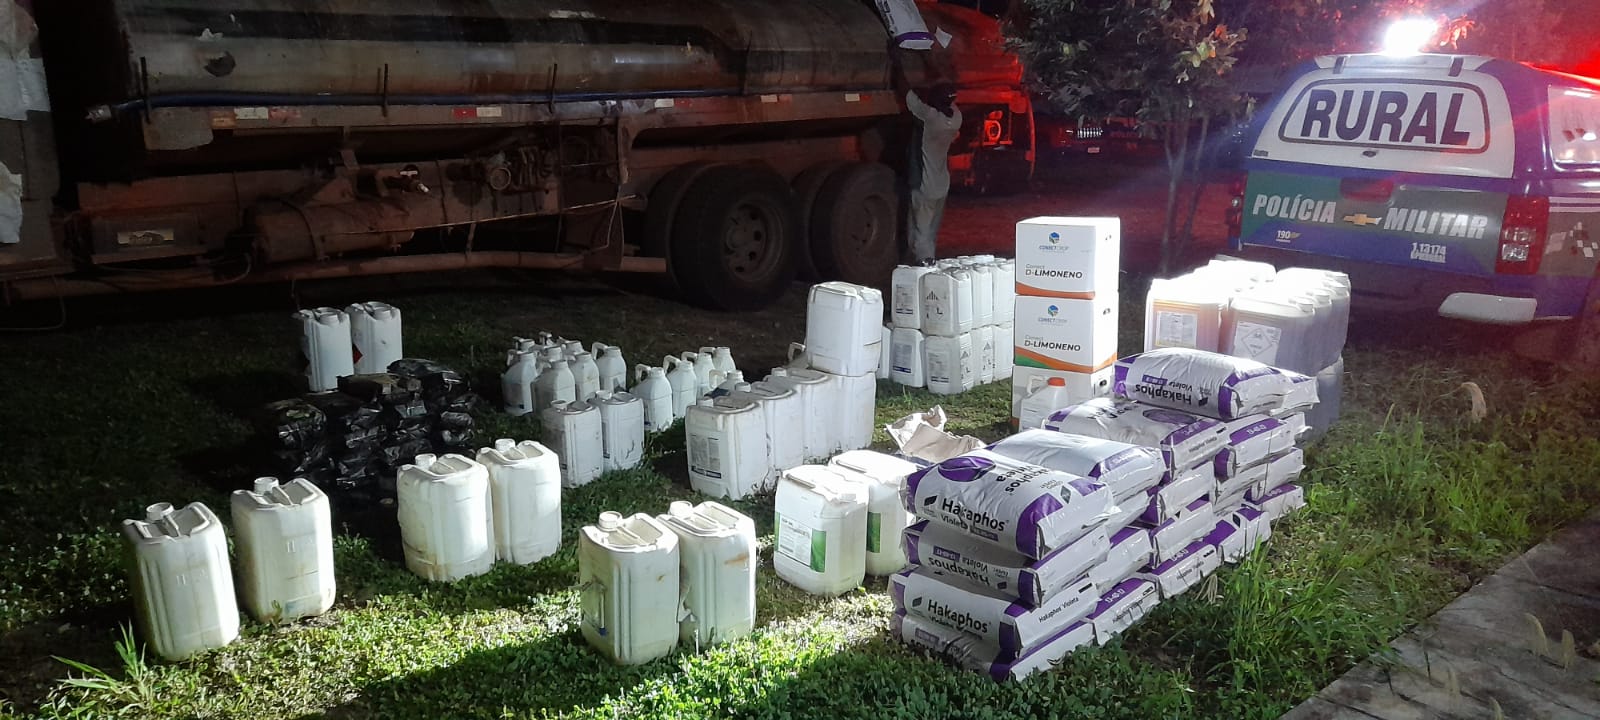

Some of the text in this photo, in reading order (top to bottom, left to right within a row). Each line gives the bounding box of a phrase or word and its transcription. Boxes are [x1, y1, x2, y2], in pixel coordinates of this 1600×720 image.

[1300, 88, 1471, 146] RURAL
[1252, 193, 1489, 240] POLÍCIA MILITAR
[1277, 230, 1291, 239] 190
[1025, 269, 1083, 279] D-LIMONENO
[1024, 340, 1081, 352] D-LIMONENO
[1135, 384, 1192, 405] Hakaphos
[941, 497, 1005, 532] Hakaphos
[927, 599, 989, 633] Hakaphos
